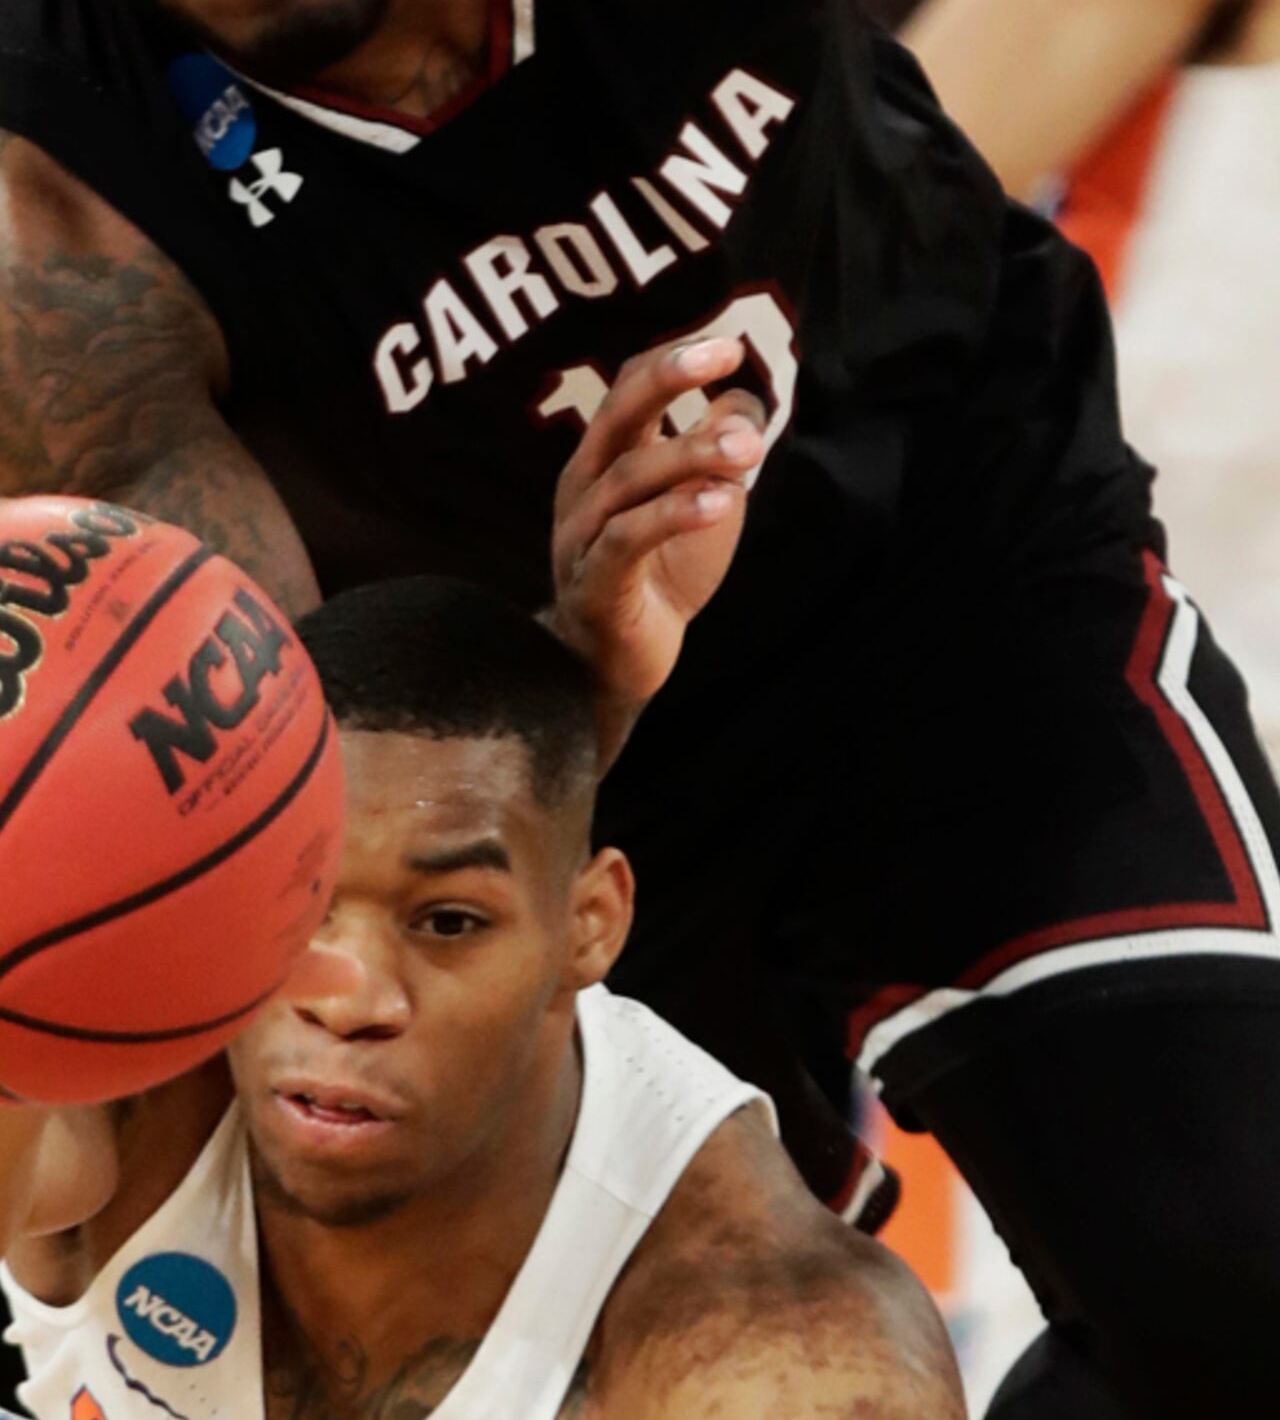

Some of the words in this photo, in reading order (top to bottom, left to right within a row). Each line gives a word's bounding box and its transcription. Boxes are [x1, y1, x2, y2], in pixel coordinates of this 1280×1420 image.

[372, 66, 798, 415] CAROLINA
[128, 587, 293, 797] NCAA
[122, 1284, 218, 1362] NCAA
